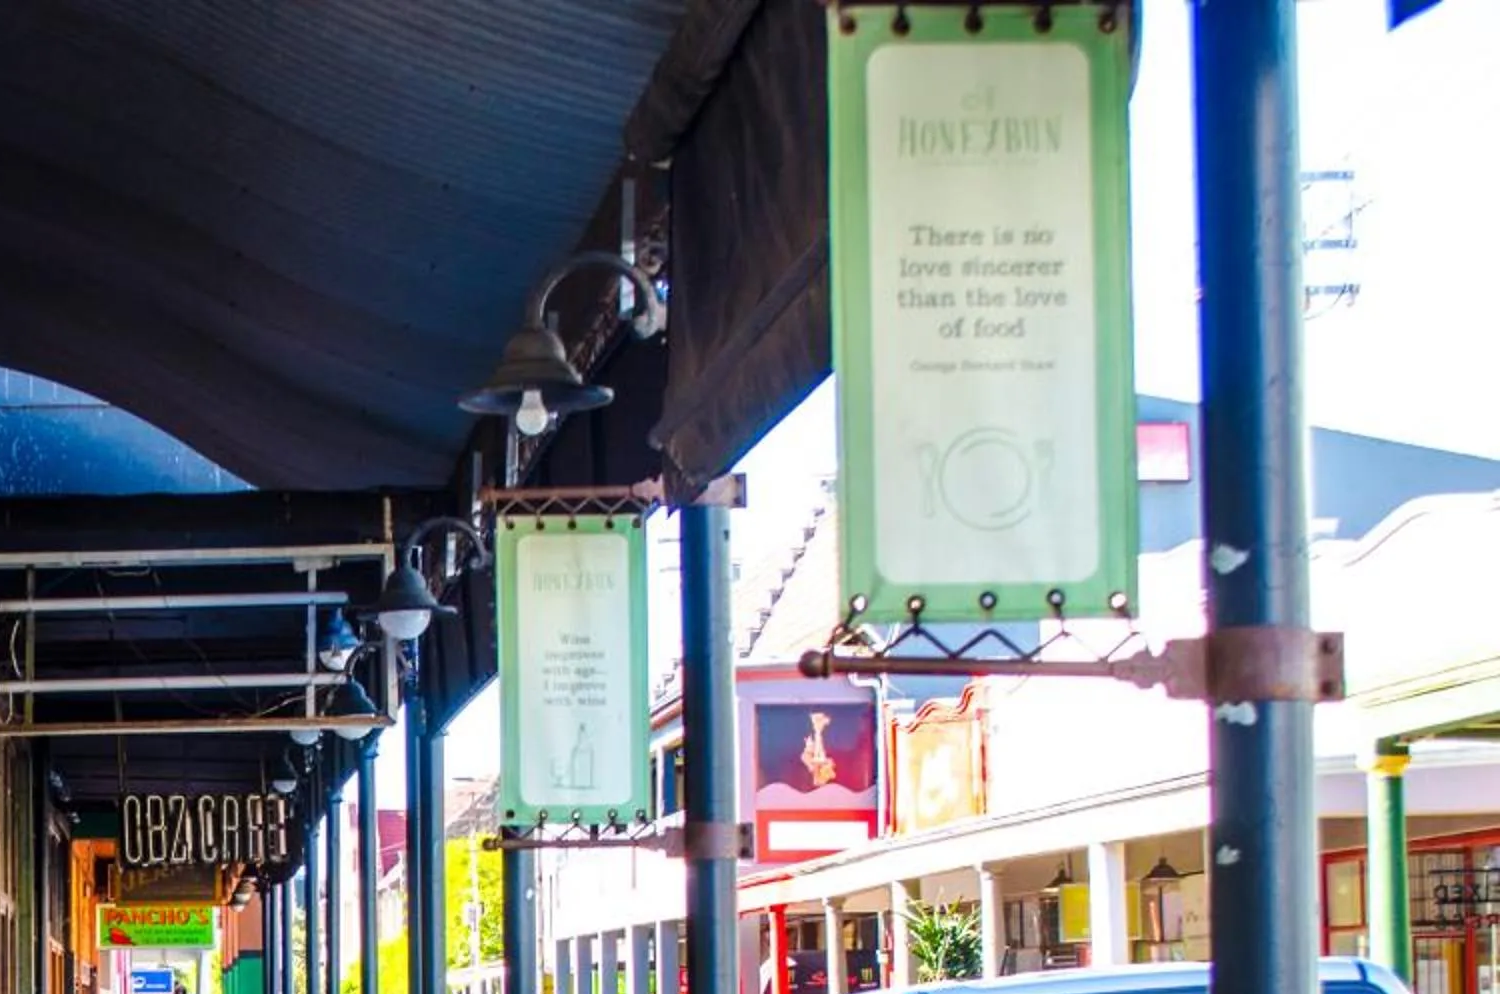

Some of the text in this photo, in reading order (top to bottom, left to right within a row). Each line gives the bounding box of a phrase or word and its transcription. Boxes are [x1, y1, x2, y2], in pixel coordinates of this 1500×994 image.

[898, 114, 1062, 158] HONEYBUN
[908, 225, 1054, 247] There is no
[900, 256, 1064, 278] love sincerer
[898, 287, 1068, 309] than the love
[939, 317, 1026, 339] of food
[123, 794, 188, 864] OBZ
[103, 908, 210, 926] PANCHO'S
